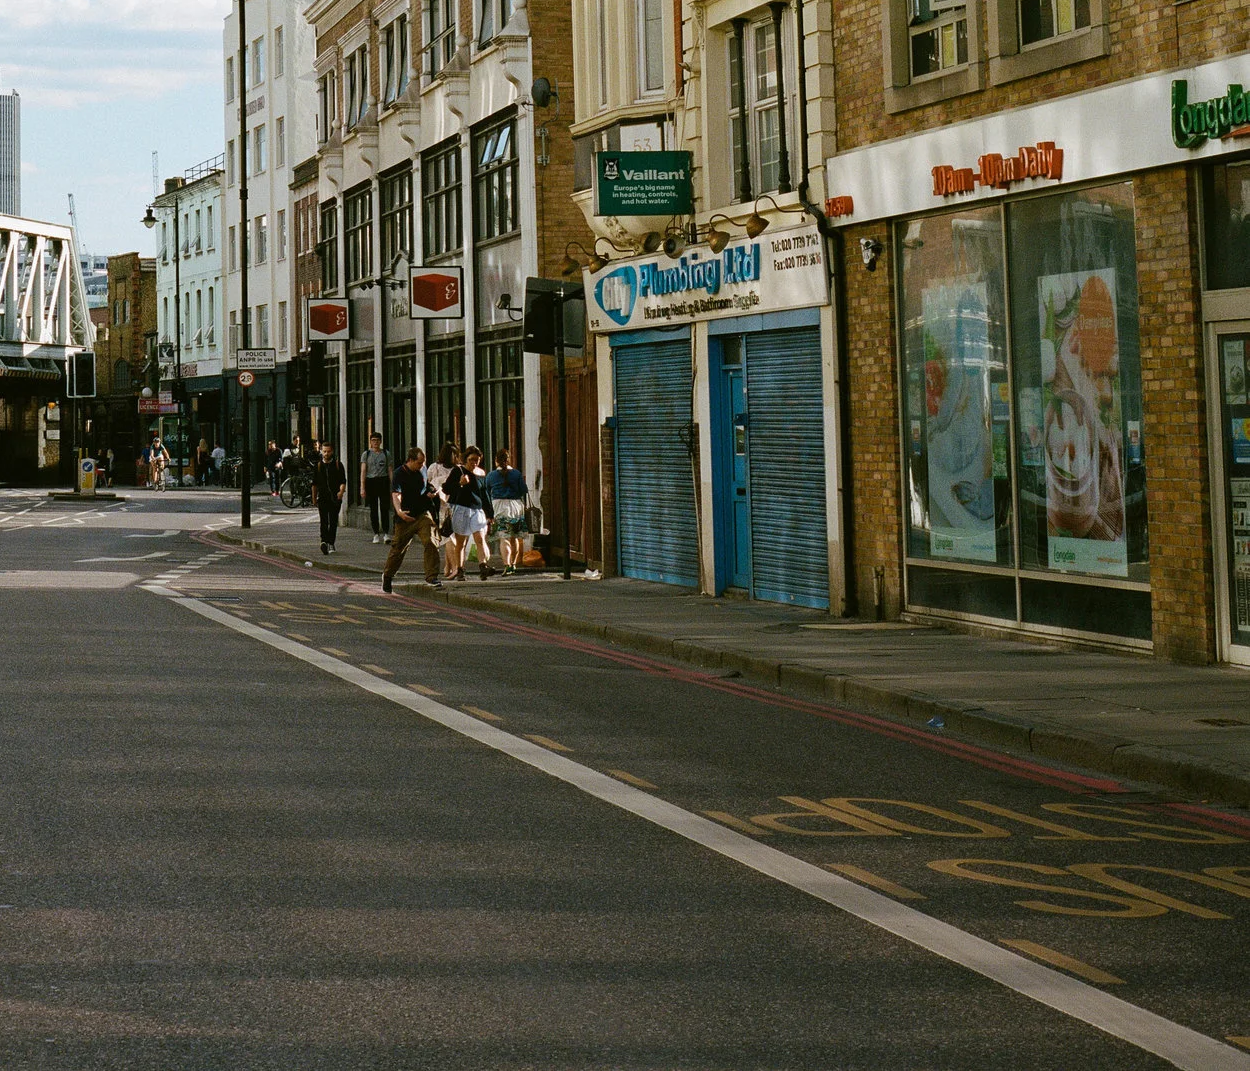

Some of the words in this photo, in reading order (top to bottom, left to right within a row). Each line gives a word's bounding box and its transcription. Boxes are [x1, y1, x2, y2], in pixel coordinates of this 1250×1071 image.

[1171, 80, 1250, 148] Longda
[622, 169, 685, 181] Vaillant
[1019, 141, 1063, 180] Daily
[639, 253, 720, 297] Plumbing
[723, 243, 760, 284] Ltd
[1053, 544, 1076, 563] Longdan
[750, 795, 1250, 844] STOP
